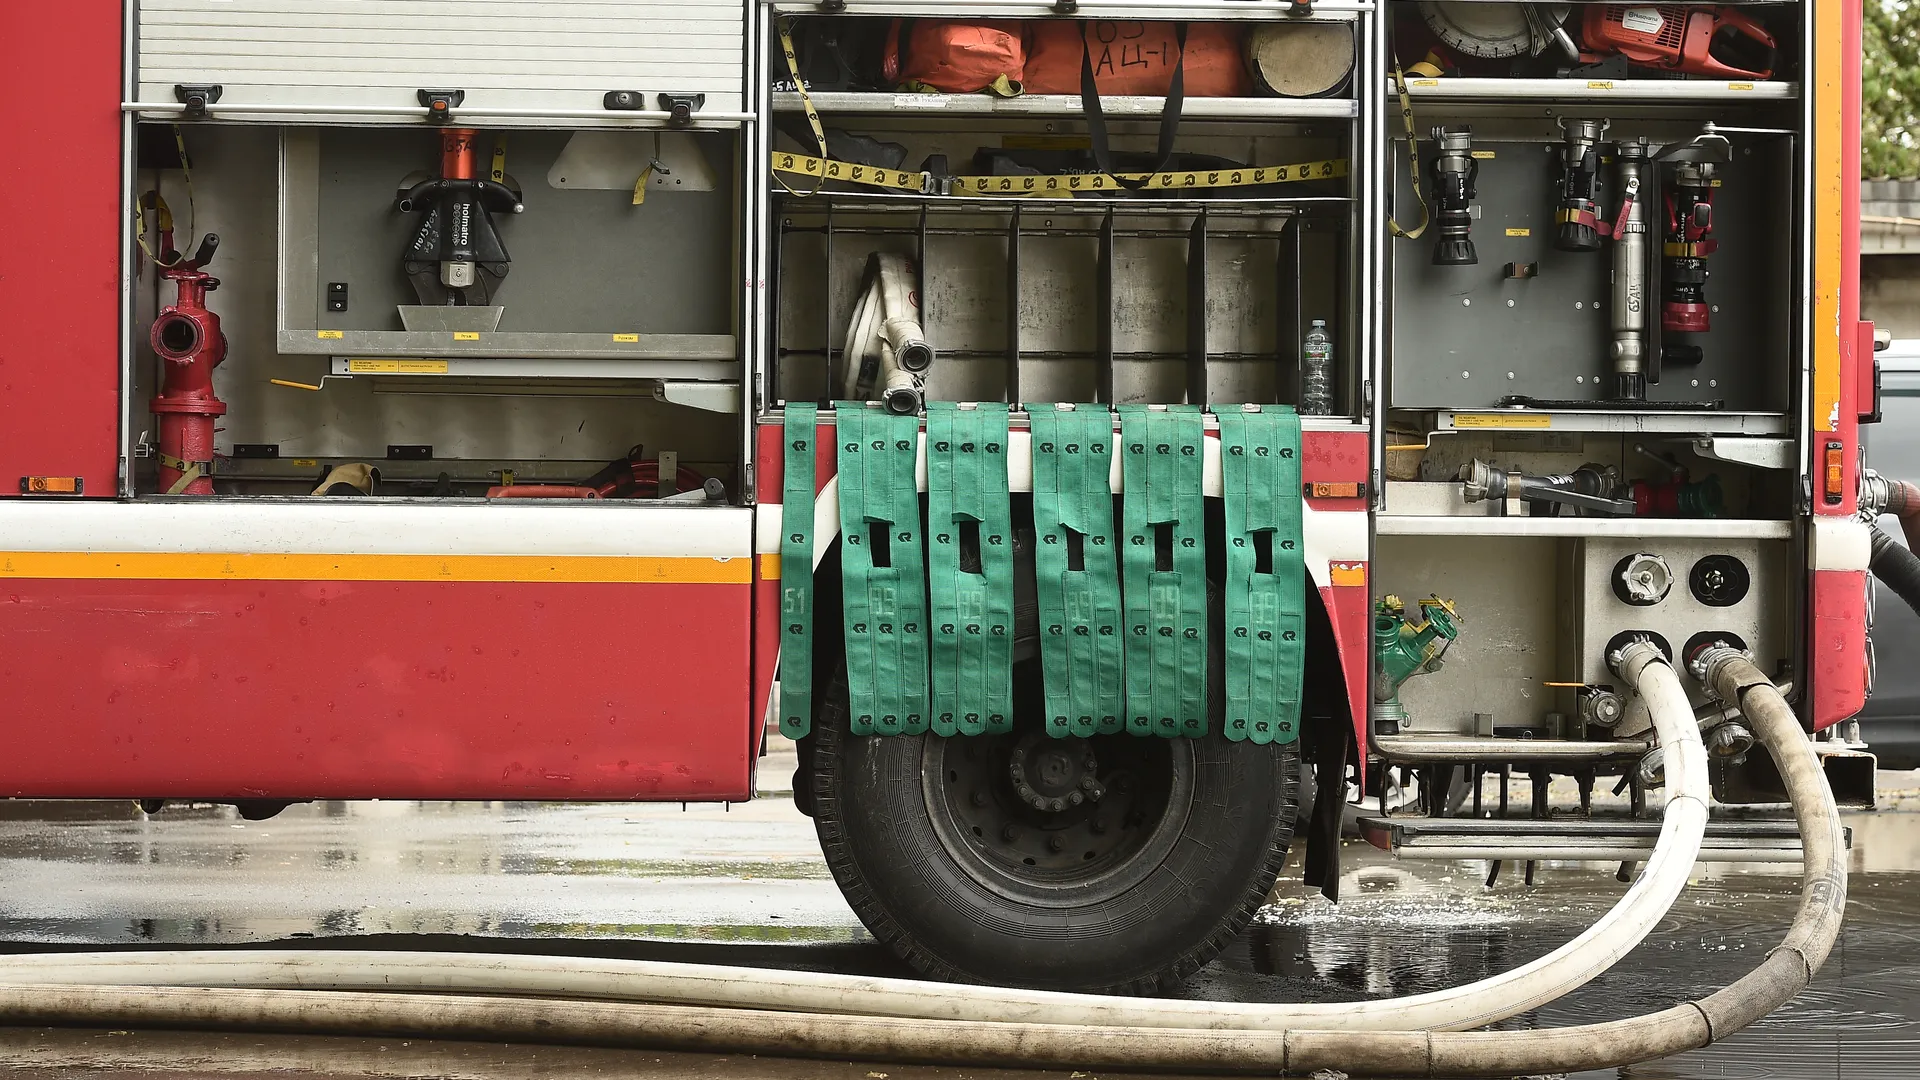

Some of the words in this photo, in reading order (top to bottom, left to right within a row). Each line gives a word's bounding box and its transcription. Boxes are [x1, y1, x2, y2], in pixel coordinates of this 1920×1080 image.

[1633, 12, 1659, 22] Husqvarna
[1095, 41, 1167, 76] АЦ-1
[460, 203, 471, 246] holmatro
[784, 586, 805, 615] 51
